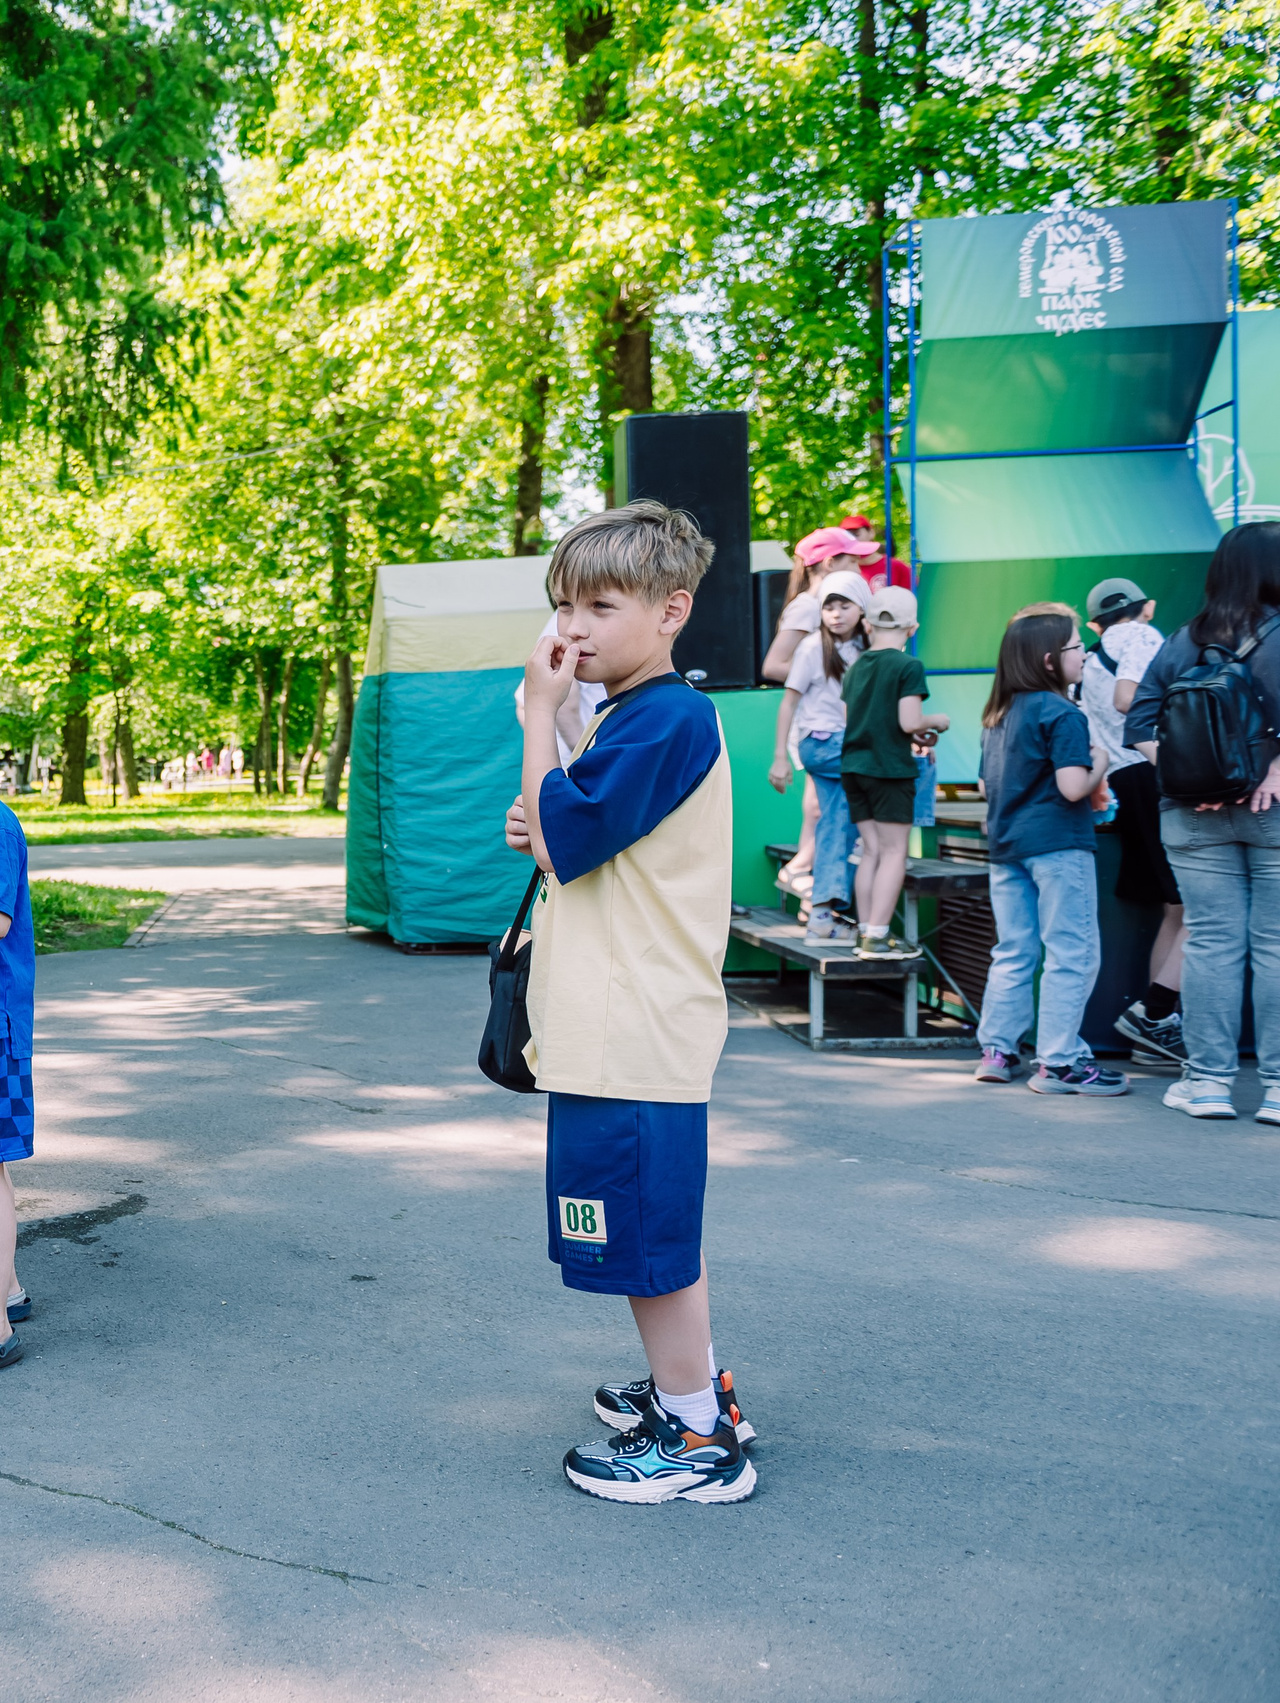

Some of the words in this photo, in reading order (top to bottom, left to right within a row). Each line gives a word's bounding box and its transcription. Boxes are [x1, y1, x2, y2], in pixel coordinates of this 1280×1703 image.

[1045, 224, 1082, 245] 100
[566, 1202, 597, 1234] 08
[564, 1242, 602, 1254] SUMMER
[564, 1250, 593, 1262] GAMES
